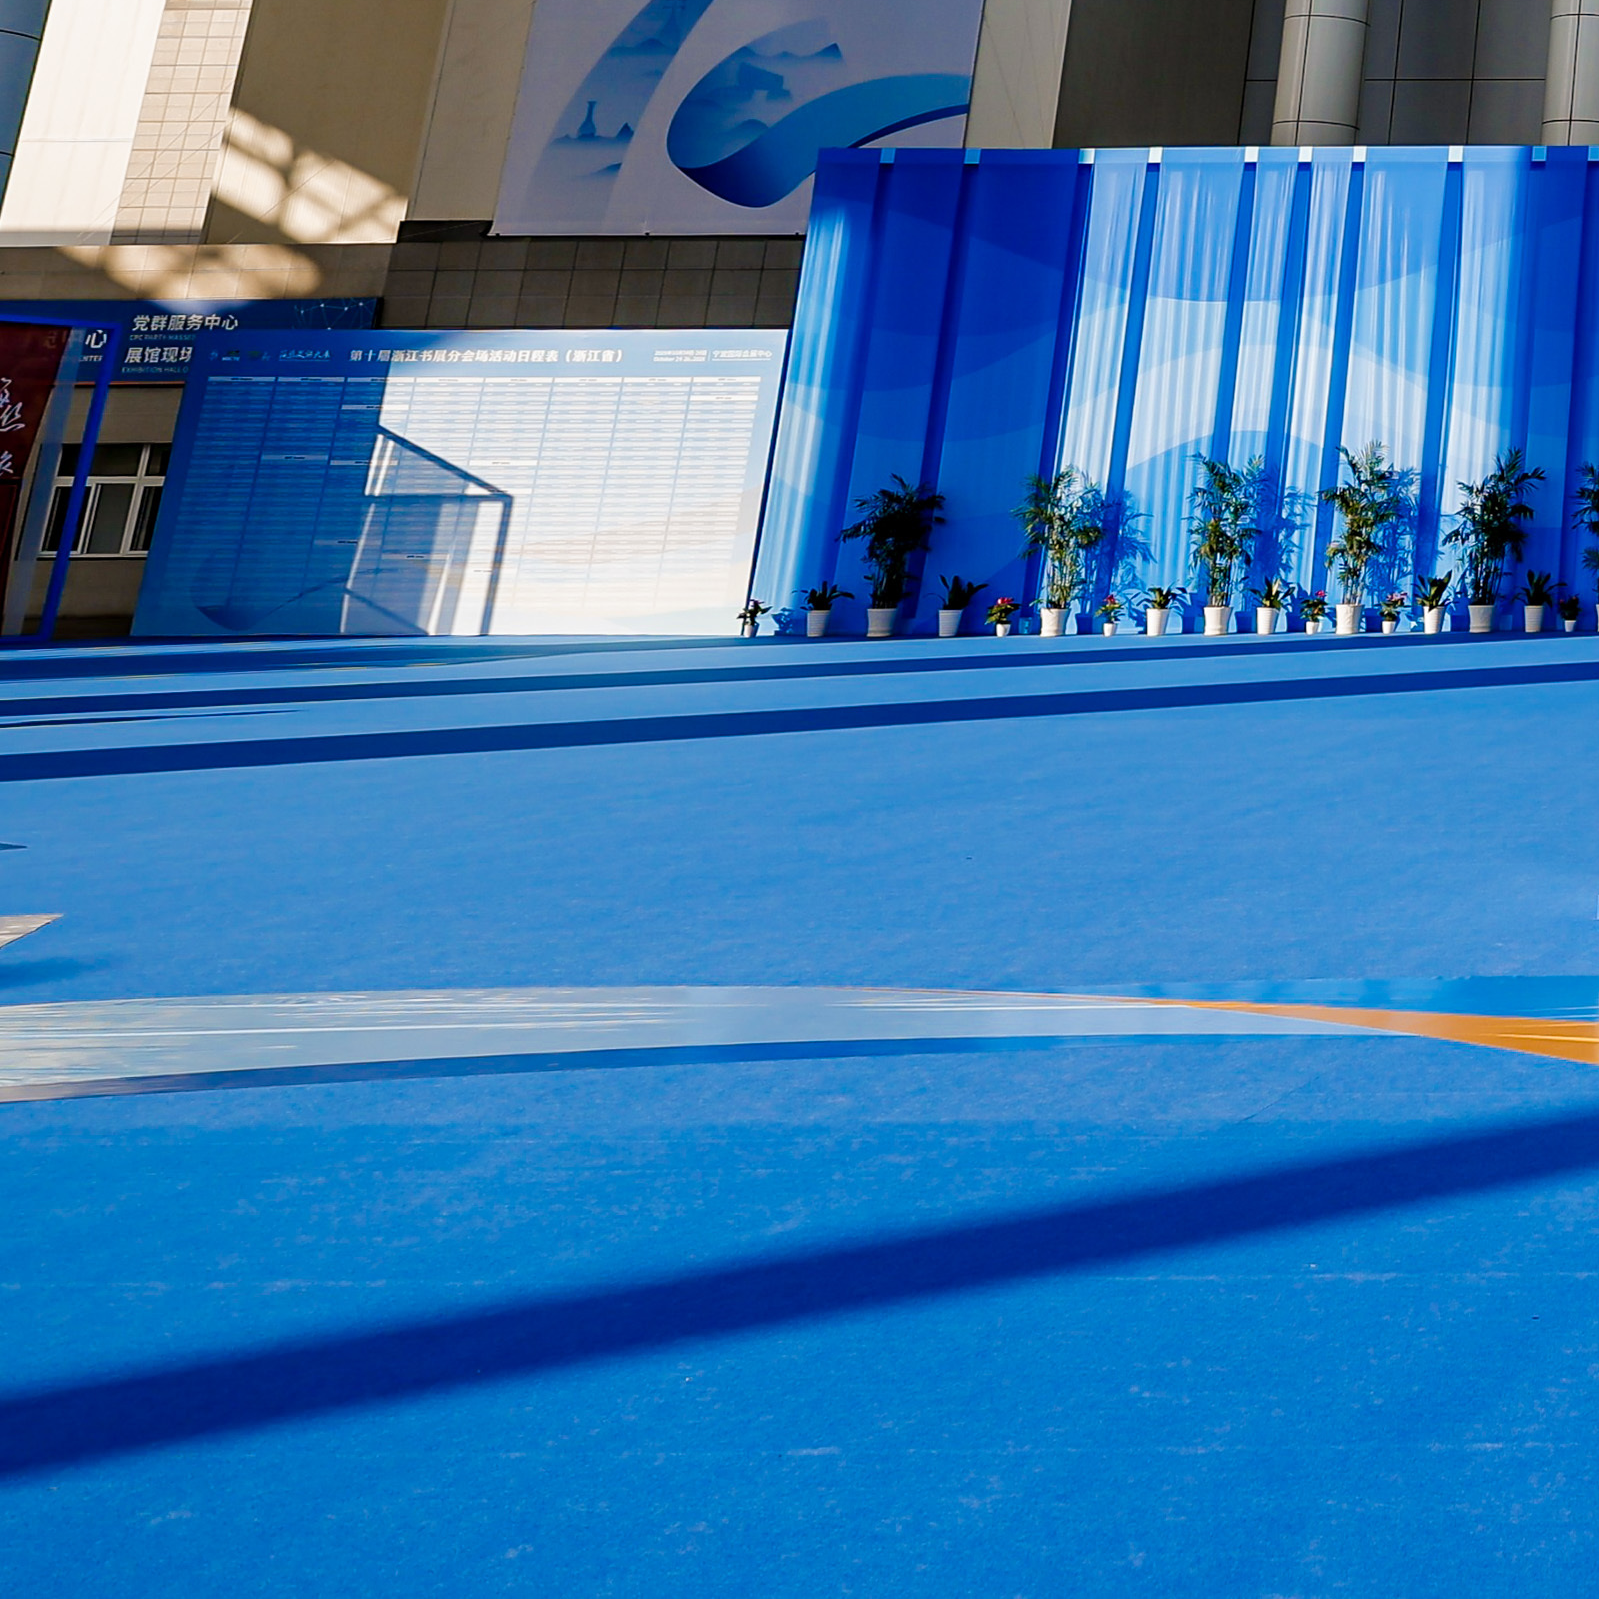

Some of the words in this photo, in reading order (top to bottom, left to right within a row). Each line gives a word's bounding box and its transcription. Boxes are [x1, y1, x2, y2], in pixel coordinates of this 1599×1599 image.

[132, 313, 239, 332] 党群服务中心
